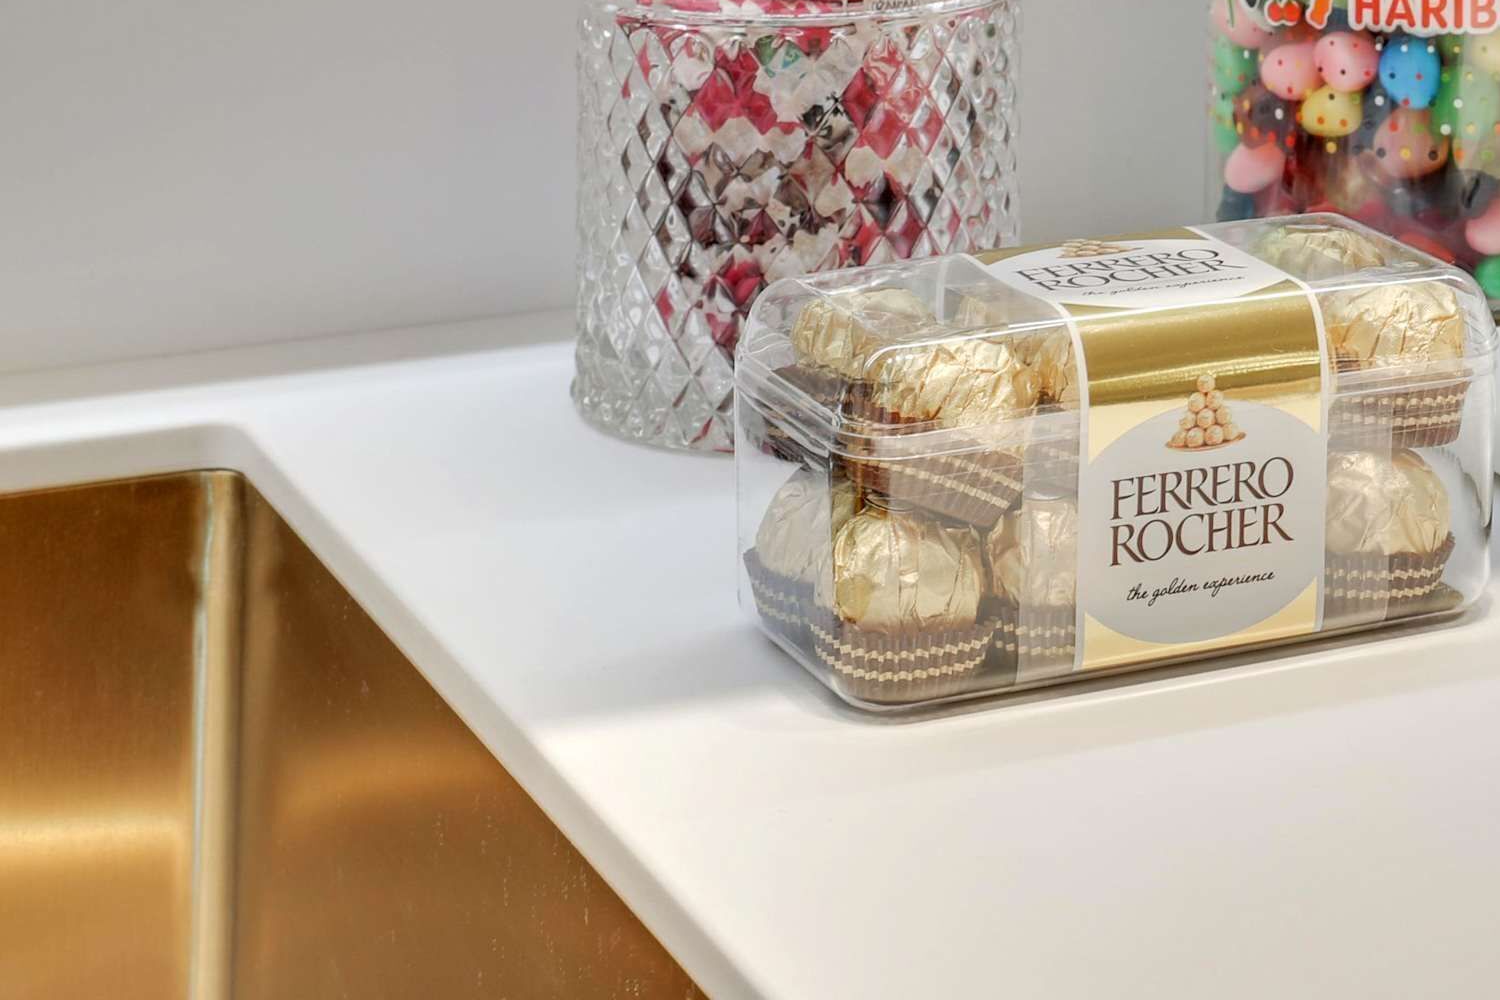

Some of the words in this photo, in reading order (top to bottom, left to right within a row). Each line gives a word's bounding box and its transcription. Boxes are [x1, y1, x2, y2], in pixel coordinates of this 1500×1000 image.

[1015, 248, 1220, 281] FERRERO
[1033, 259, 1248, 291] ROCHER
[1081, 288, 1104, 297] the
[1110, 284, 1160, 296] golden
[1165, 275, 1246, 289] experience
[1109, 455, 1295, 521] FERRERO
[1109, 502, 1295, 567] ROCHER
[1126, 582, 1149, 601] the
[1147, 576, 1200, 607] golden
[1202, 570, 1275, 598] experience
